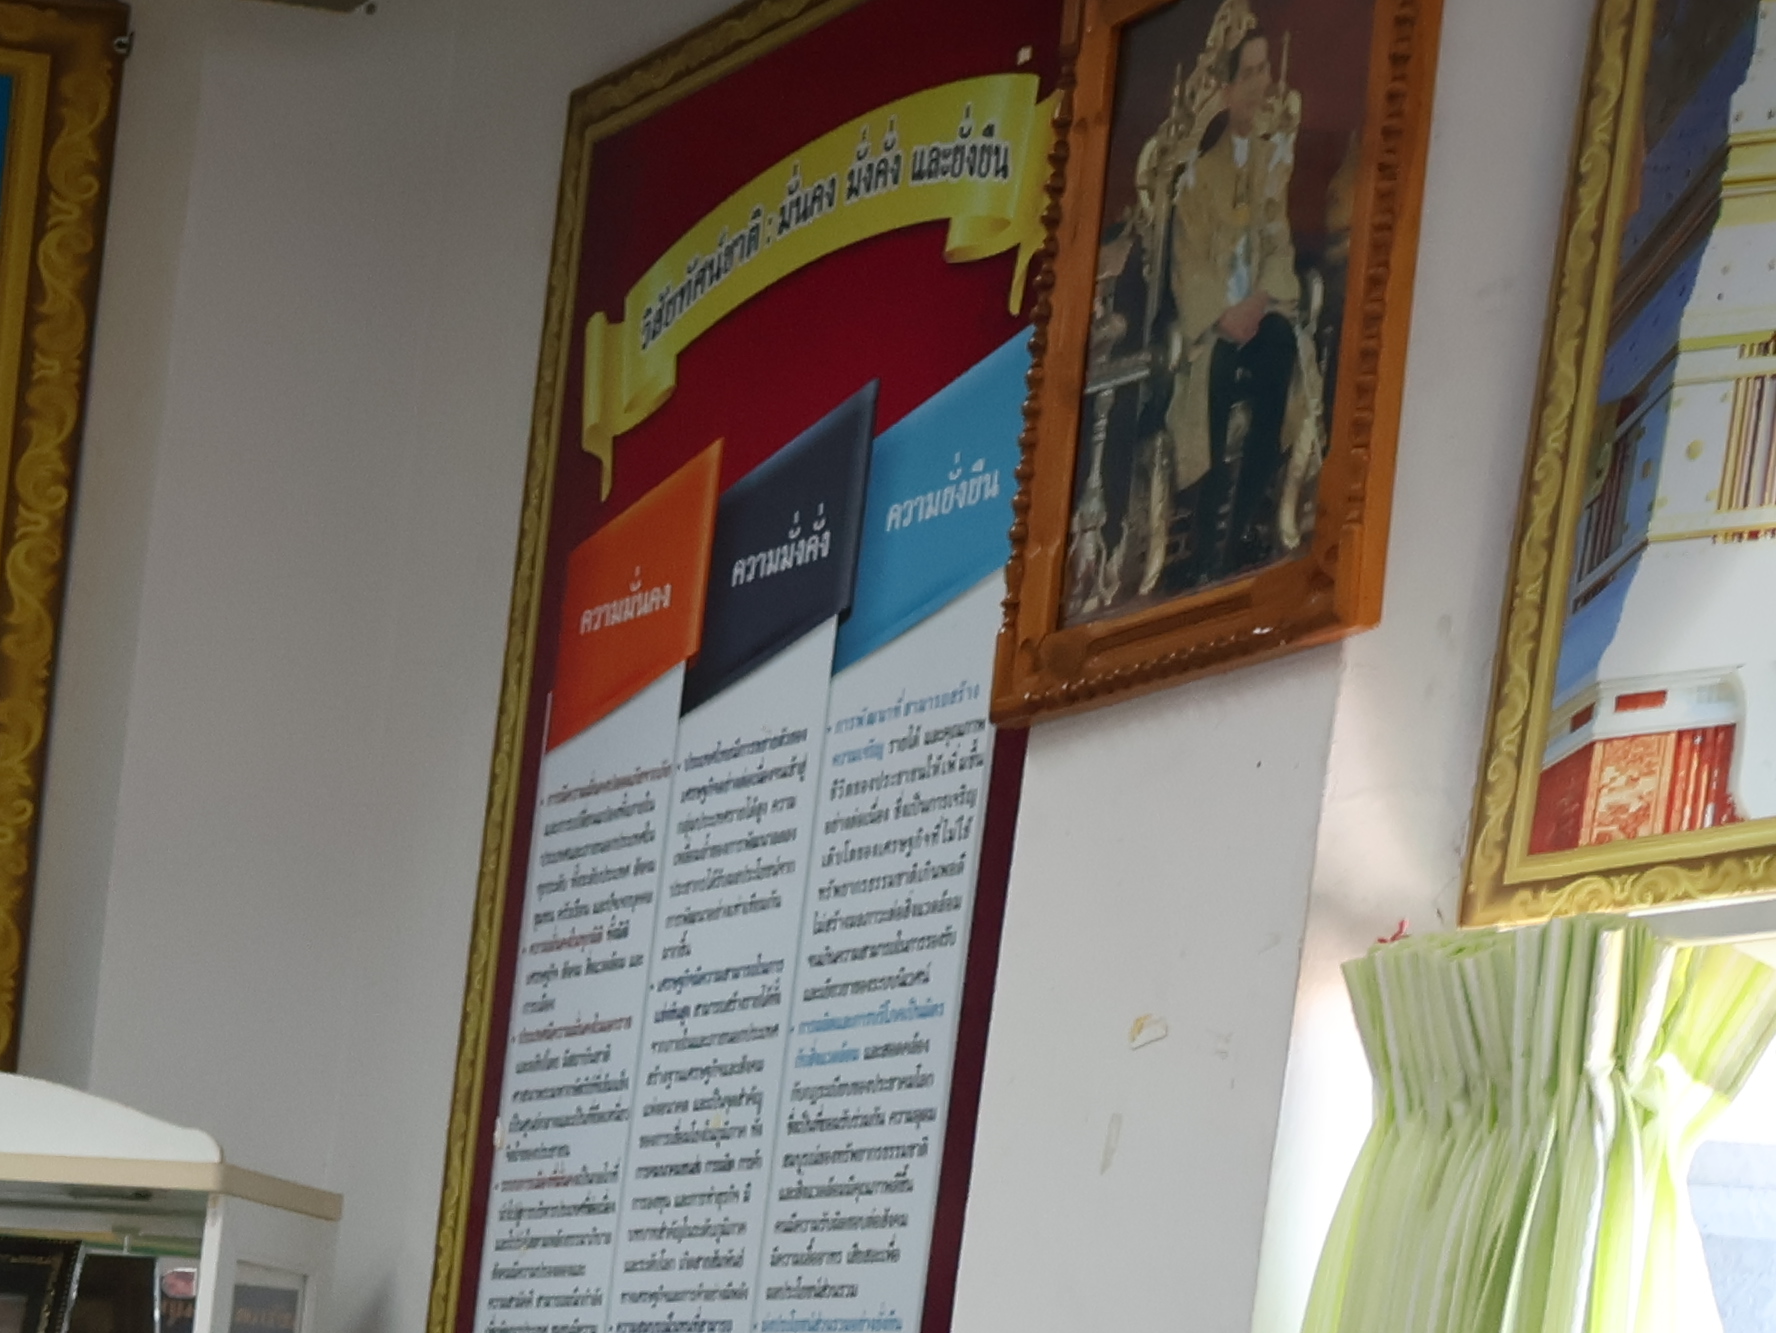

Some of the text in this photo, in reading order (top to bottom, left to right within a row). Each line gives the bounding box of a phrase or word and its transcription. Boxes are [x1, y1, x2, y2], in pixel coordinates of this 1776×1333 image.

[777, 162, 837, 237] มั่นคง
[846, 116, 903, 204] มั่งคั่ง
[910, 102, 1010, 182] และยั่งยืน
[885, 452, 1000, 533] ความยั่งยืน
[731, 502, 831, 588] ความมั่งคั่ง
[579, 566, 672, 636] ความมั่นคง
